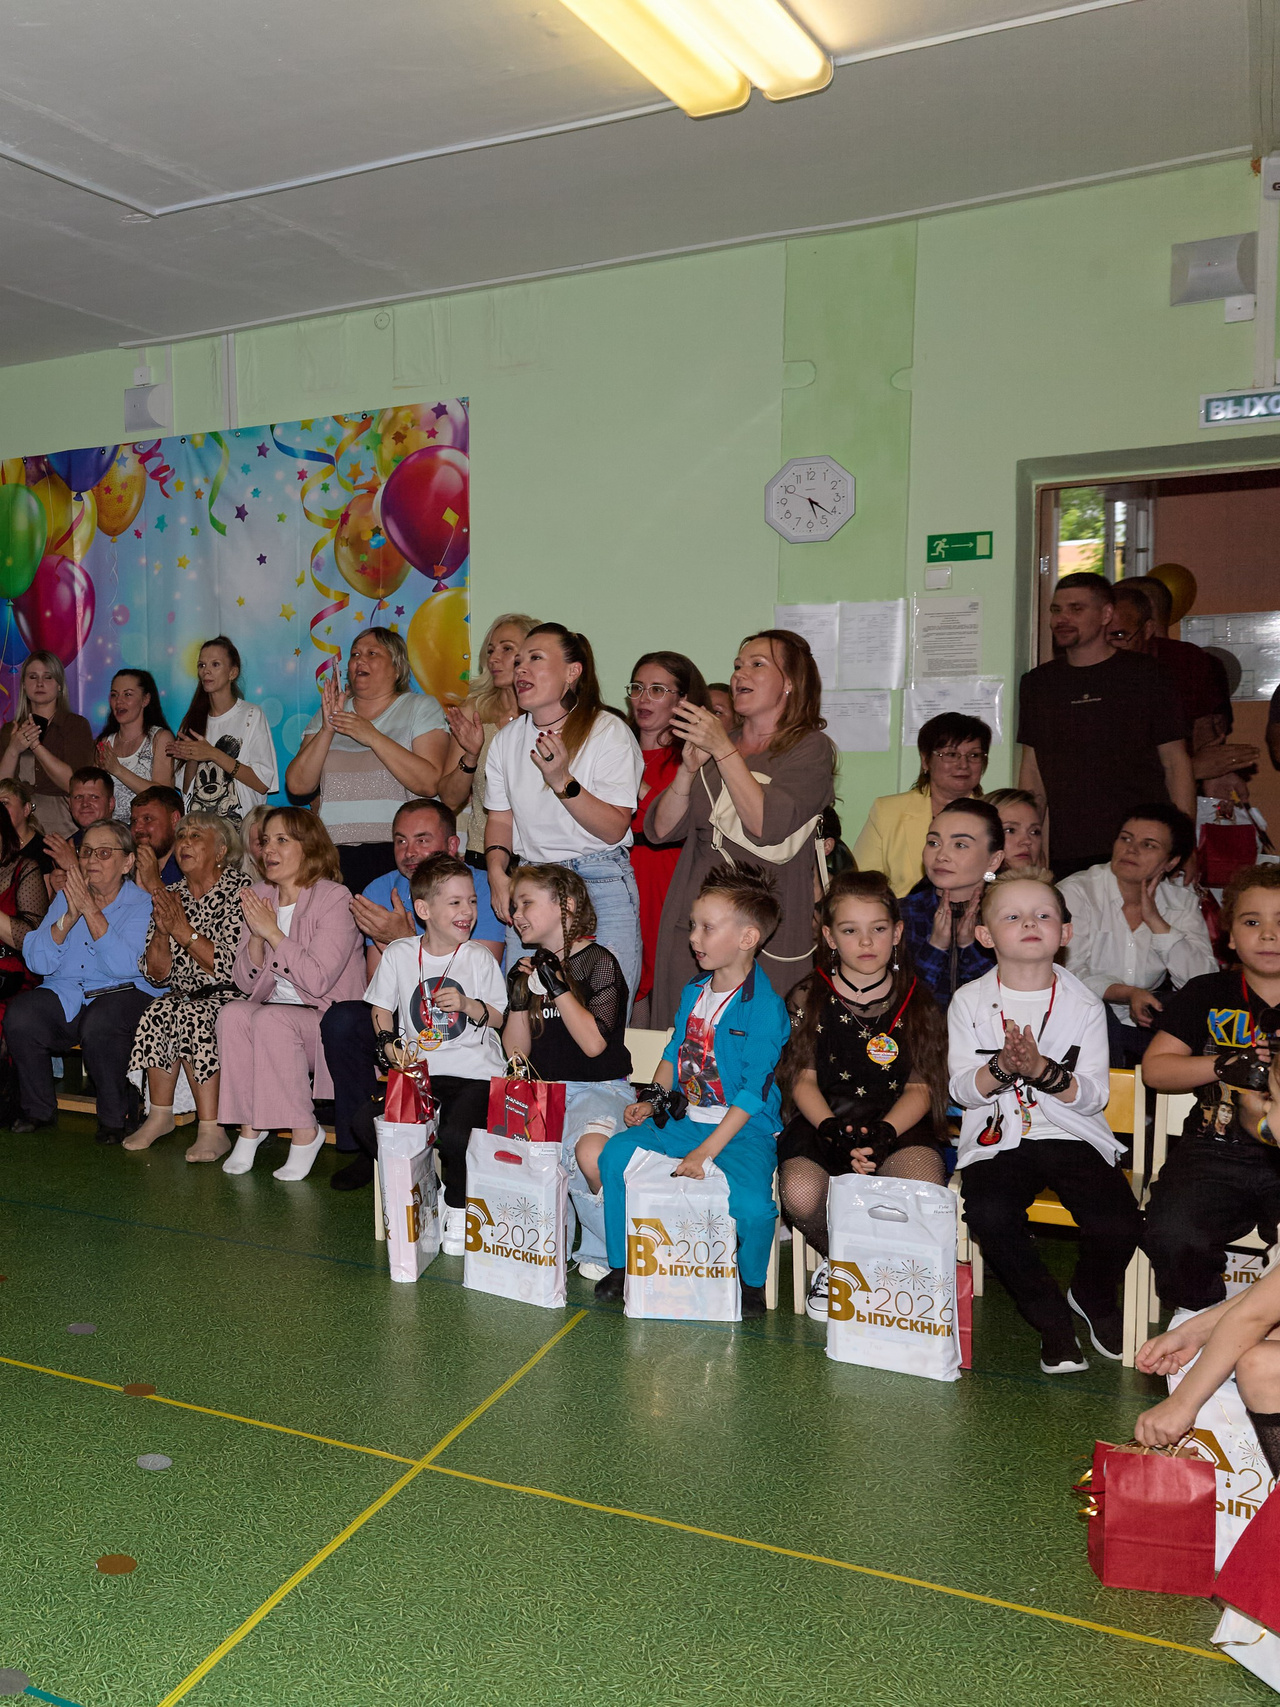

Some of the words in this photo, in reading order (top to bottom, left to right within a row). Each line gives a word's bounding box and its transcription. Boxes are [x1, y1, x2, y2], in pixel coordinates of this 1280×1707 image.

[795, 474, 802, 484] 11
[806, 471, 816, 480] 12
[823, 472, 827, 481] 1
[784, 484, 796, 494] 10
[830, 480, 838, 490] 2
[833, 493, 841, 502] 3
[780, 498, 788, 507] 9
[784, 510, 792, 519] 8
[795, 517, 802, 526] 7
[806, 520, 814, 529] 6
[819, 515, 828, 525] 5
[496, 1221, 557, 1254] 2026
[627, 1234, 738, 1279] ВЫПУСКНИ
[874, 1287, 954, 1323] 2026
